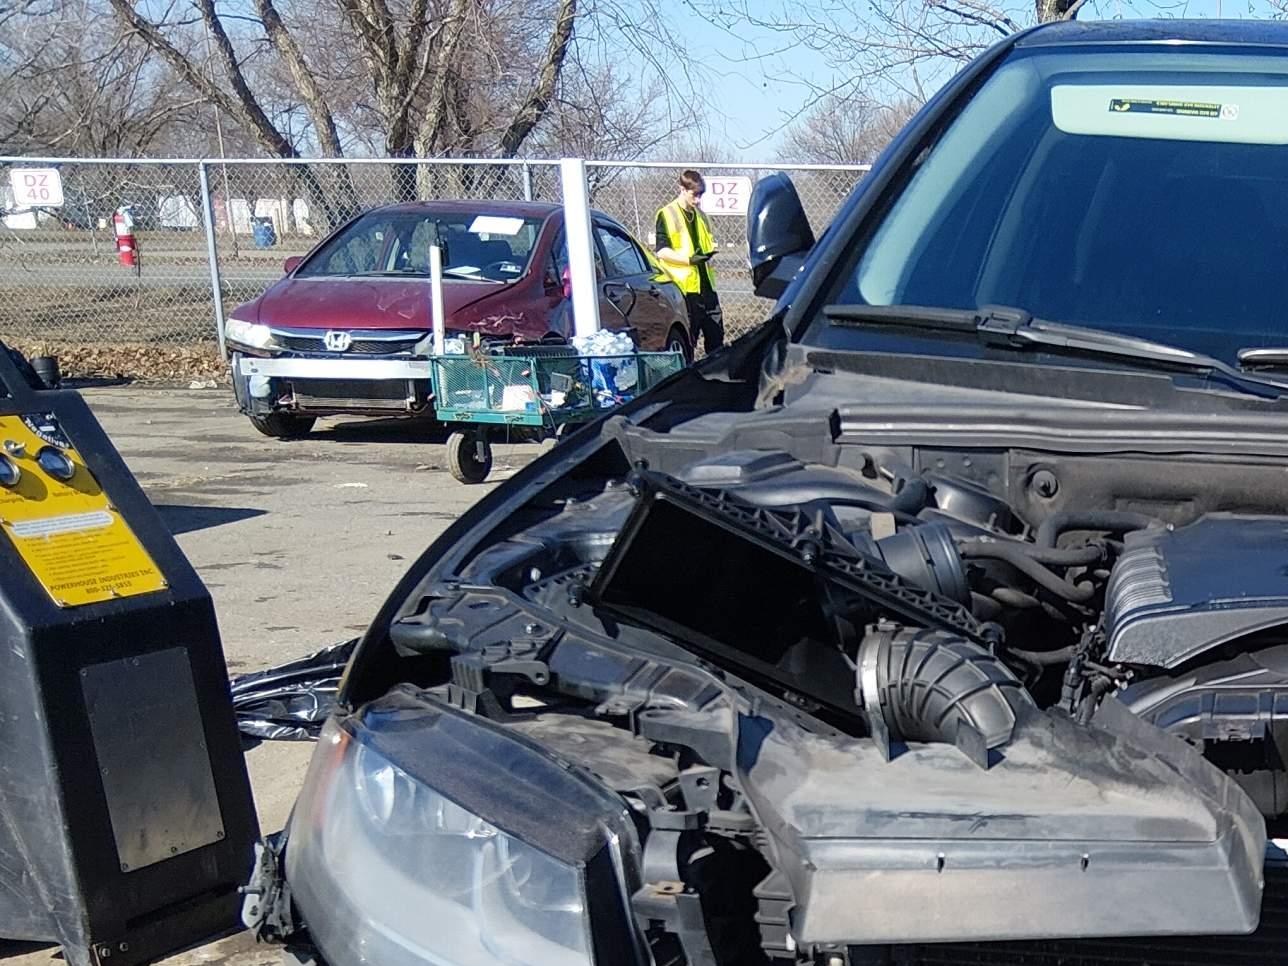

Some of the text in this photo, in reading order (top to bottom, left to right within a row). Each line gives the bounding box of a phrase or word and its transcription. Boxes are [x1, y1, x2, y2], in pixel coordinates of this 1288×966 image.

[23, 174, 49, 187] DZ
[26, 188, 50, 201] 40
[711, 182, 739, 195] DZ
[714, 197, 739, 209] 42
